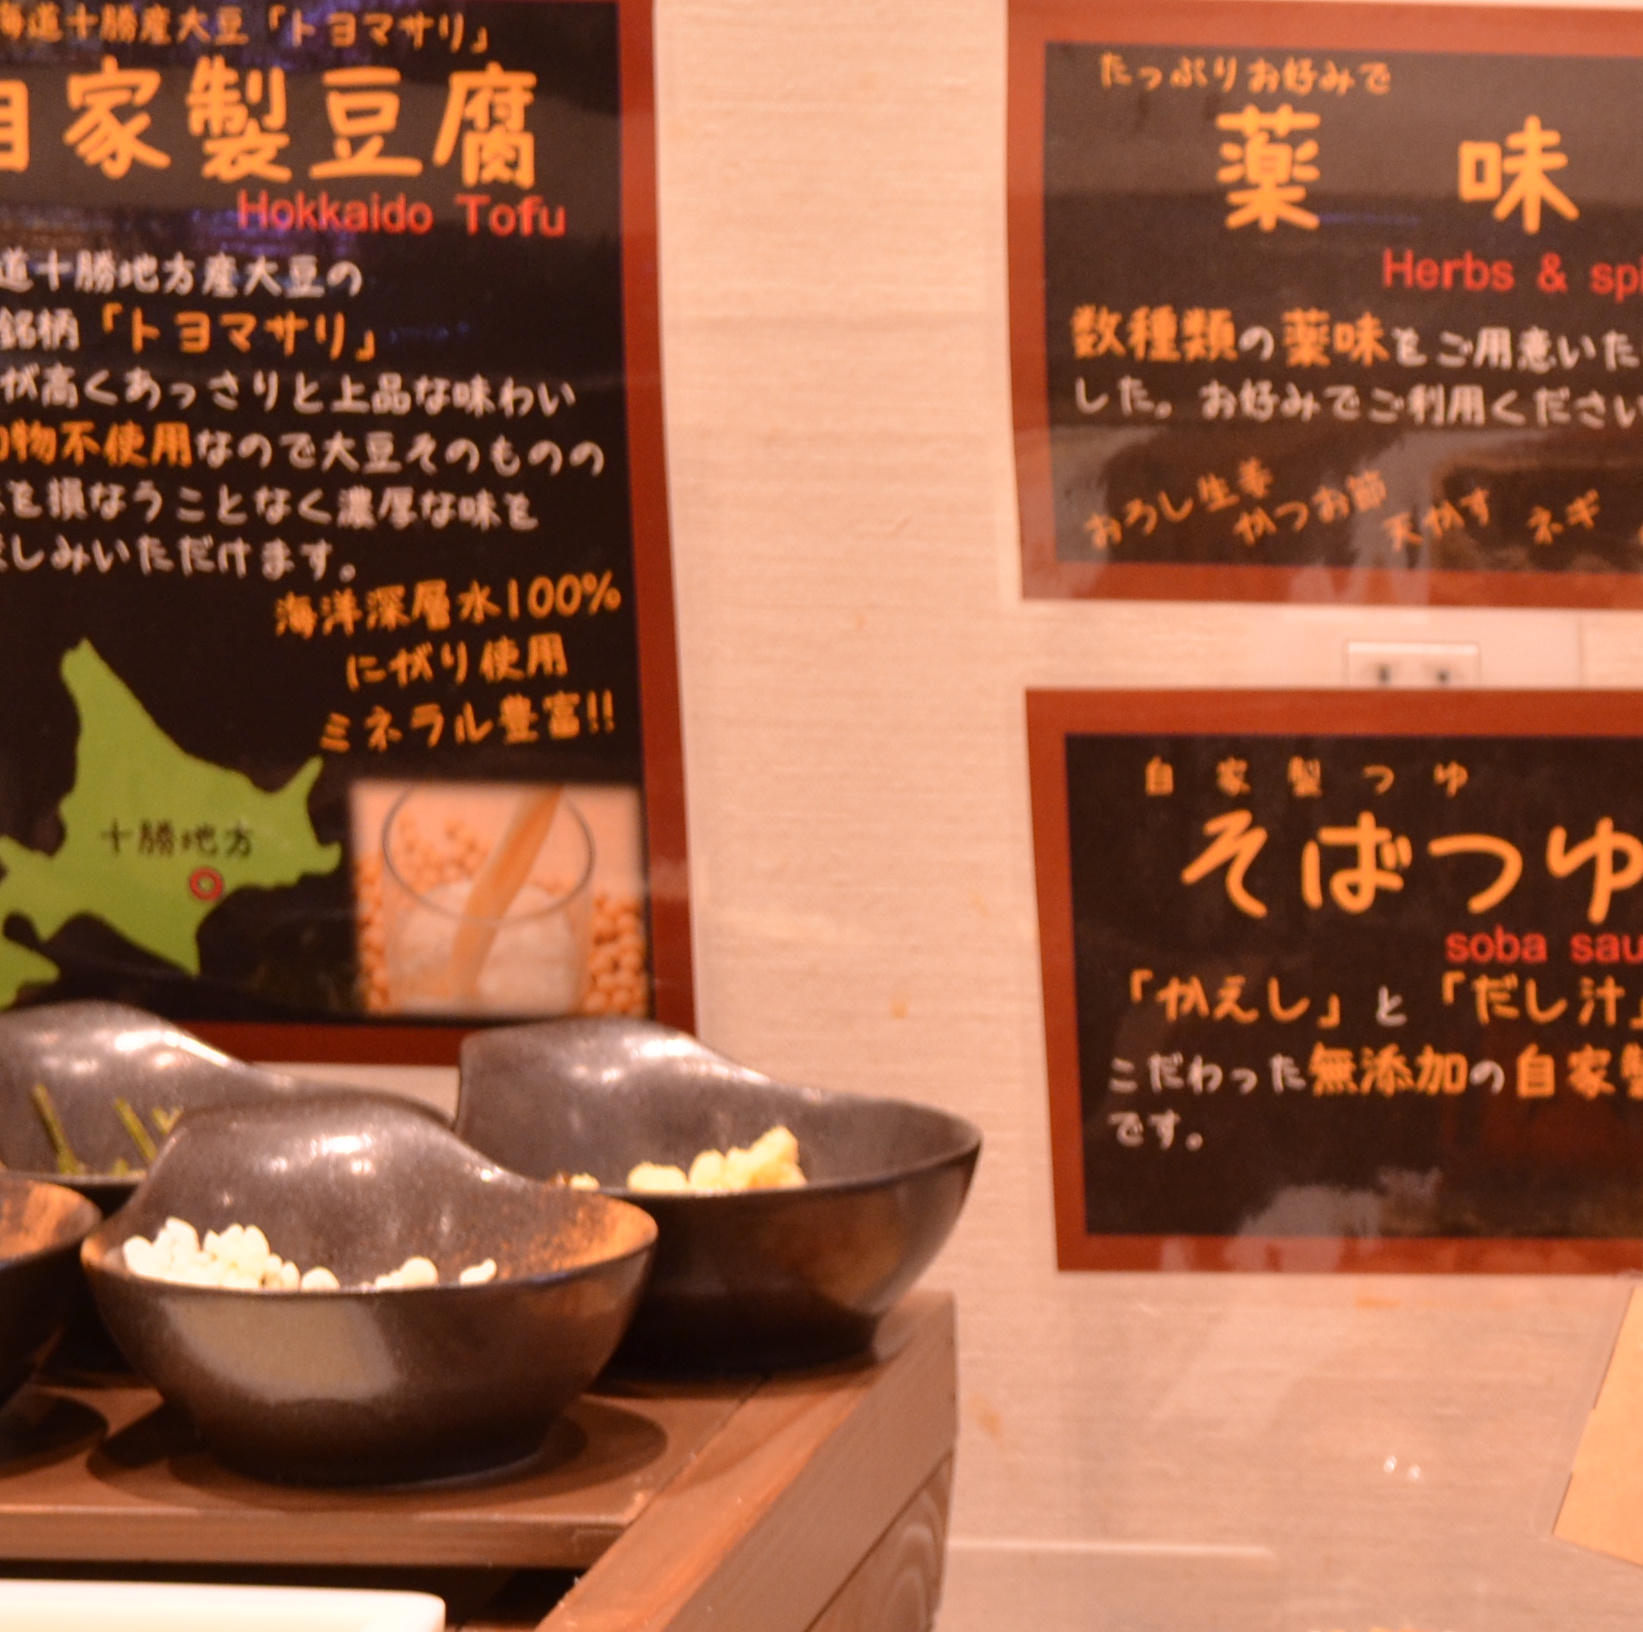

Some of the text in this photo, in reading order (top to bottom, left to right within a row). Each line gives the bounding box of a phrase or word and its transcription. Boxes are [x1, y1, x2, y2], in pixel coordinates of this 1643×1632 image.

[1099, 52, 1392, 95] たっぷりお好みで
[236, 190, 565, 236] Hokkaido Tofu
[1382, 249, 1514, 291] Herbs
[1536, 254, 1567, 292] &
[0, 419, 604, 474] 物不使用なので大豆そのものの
[1528, 488, 1601, 546] ネギ
[0, 532, 357, 582] しみいただけます。
[345, 633, 567, 690] にがり使用
[101, 819, 254, 857] 十勝地方
[1445, 926, 1547, 964] soba
[1108, 1109, 1204, 1151] です。
